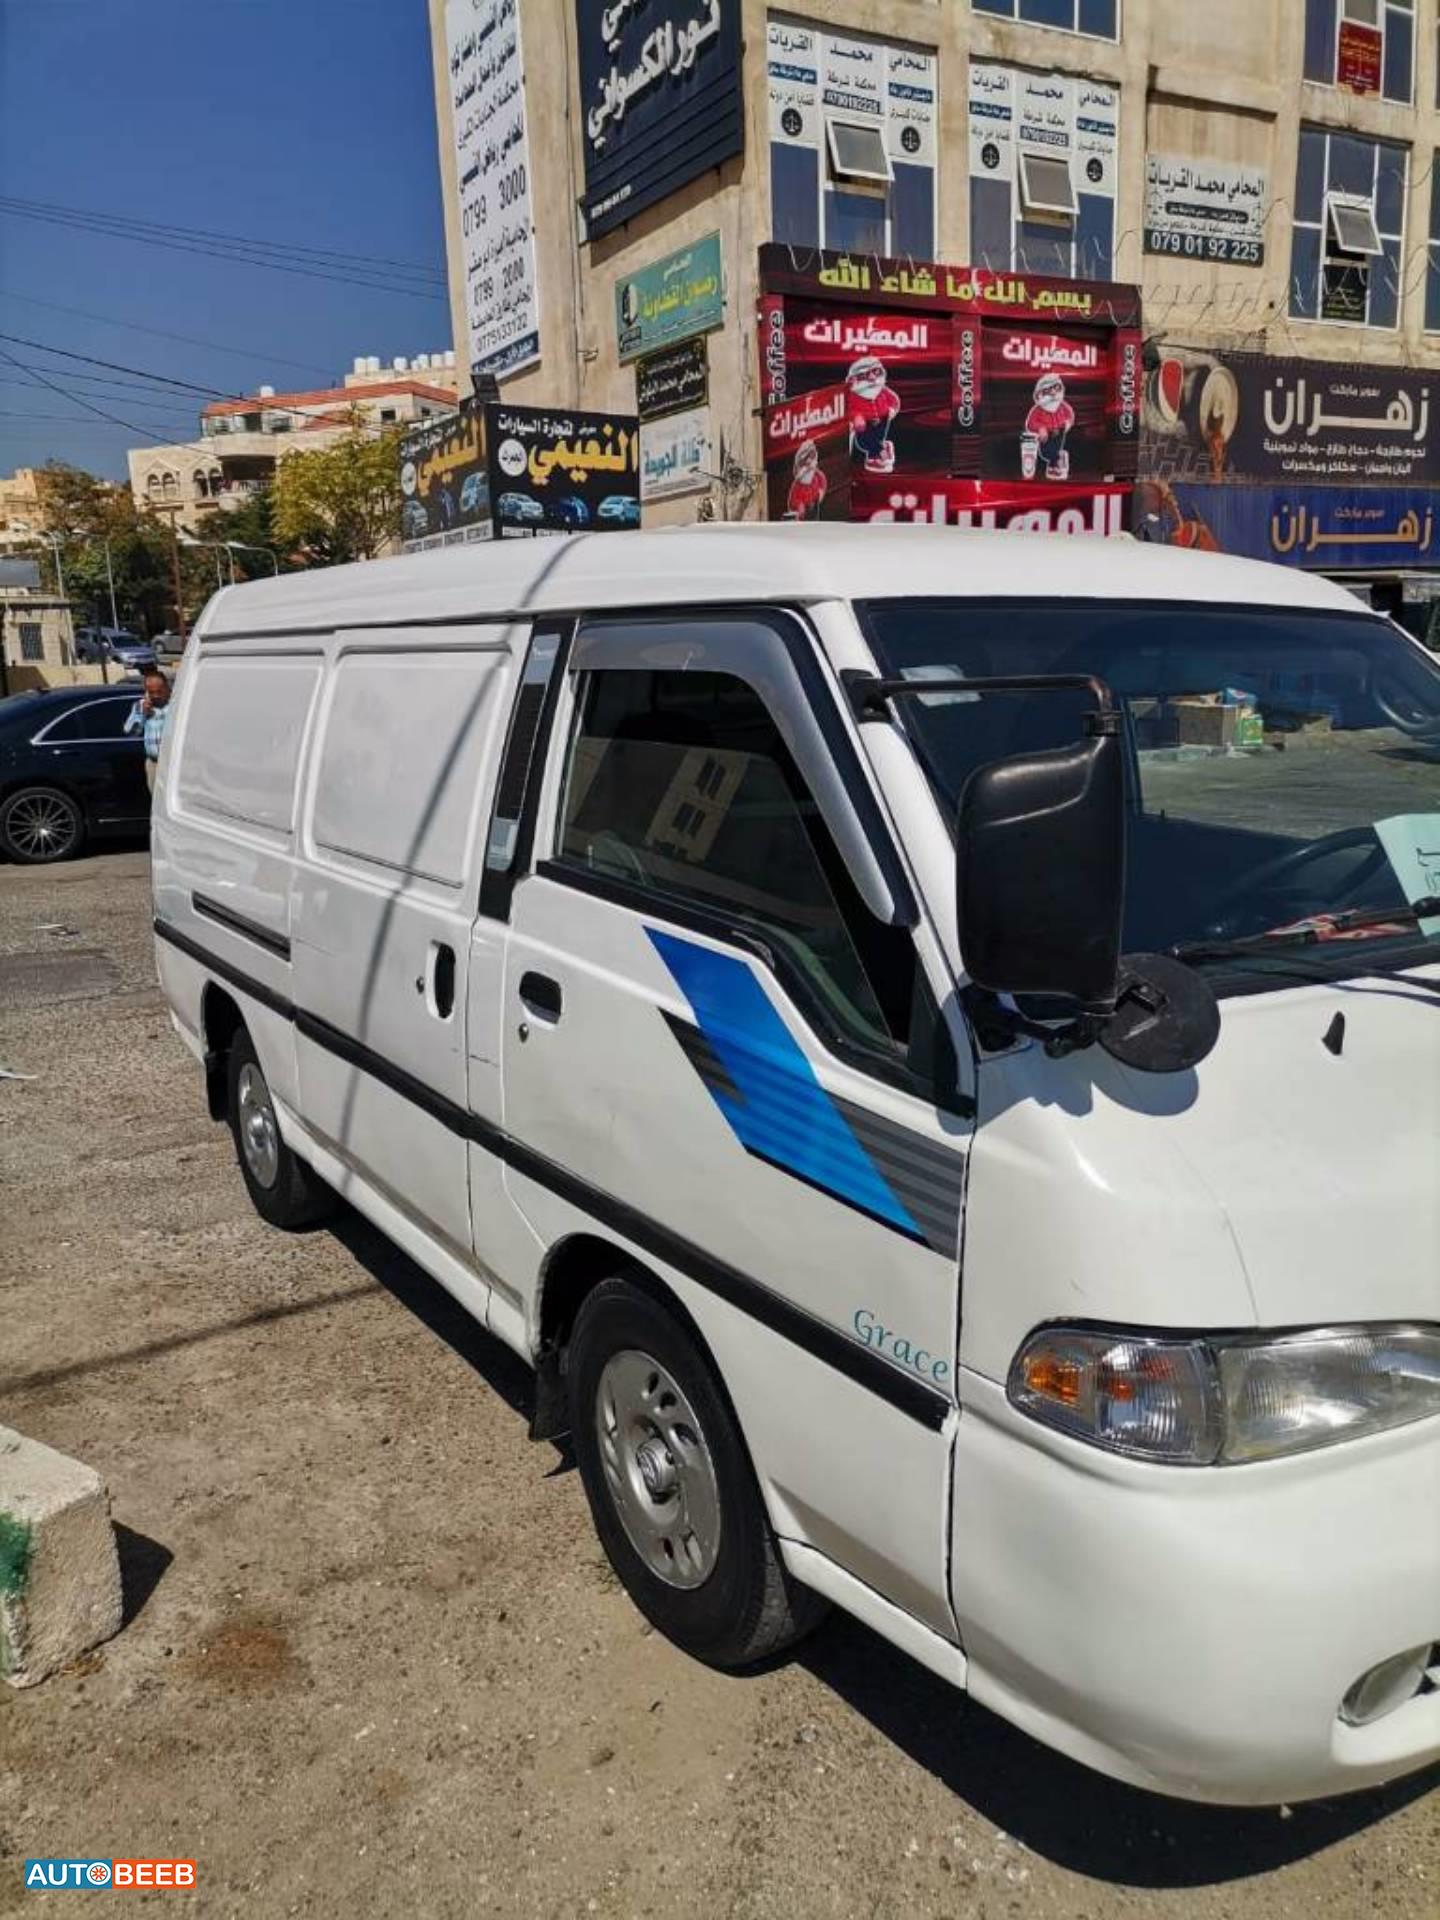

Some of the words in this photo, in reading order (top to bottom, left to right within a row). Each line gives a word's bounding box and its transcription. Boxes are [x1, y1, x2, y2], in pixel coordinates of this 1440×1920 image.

[829, 43, 873, 62] محمد
[889, 56, 931, 73] المحامي
[587, 20, 674, 149] الكسواني
[1025, 82, 1064, 98] محمد
[1078, 92, 1115, 108] المحامي
[1194, 174, 1225, 193] محمد
[1228, 172, 1264, 203] المحامي
[1150, 231, 1181, 252] 079
[1185, 235, 1204, 255] 01
[1208, 238, 1228, 258] 92
[1231, 241, 1260, 262] 225
[818, 258, 871, 290] الله
[880, 267, 937, 296] شاء
[945, 275, 973, 300] ما
[983, 279, 1024, 305] الله
[1032, 290, 1091, 316] بسم
[957, 330, 975, 428] Coffee
[1119, 343, 1136, 435] Coffee
[1263, 377, 1430, 442] زهران
[498, 414, 540, 436] السيارات
[543, 418, 573, 439] لتجارة
[528, 424, 639, 486] النعيمي
[1272, 506, 1433, 553] زهران
[854, 1309, 948, 1381] Grace
